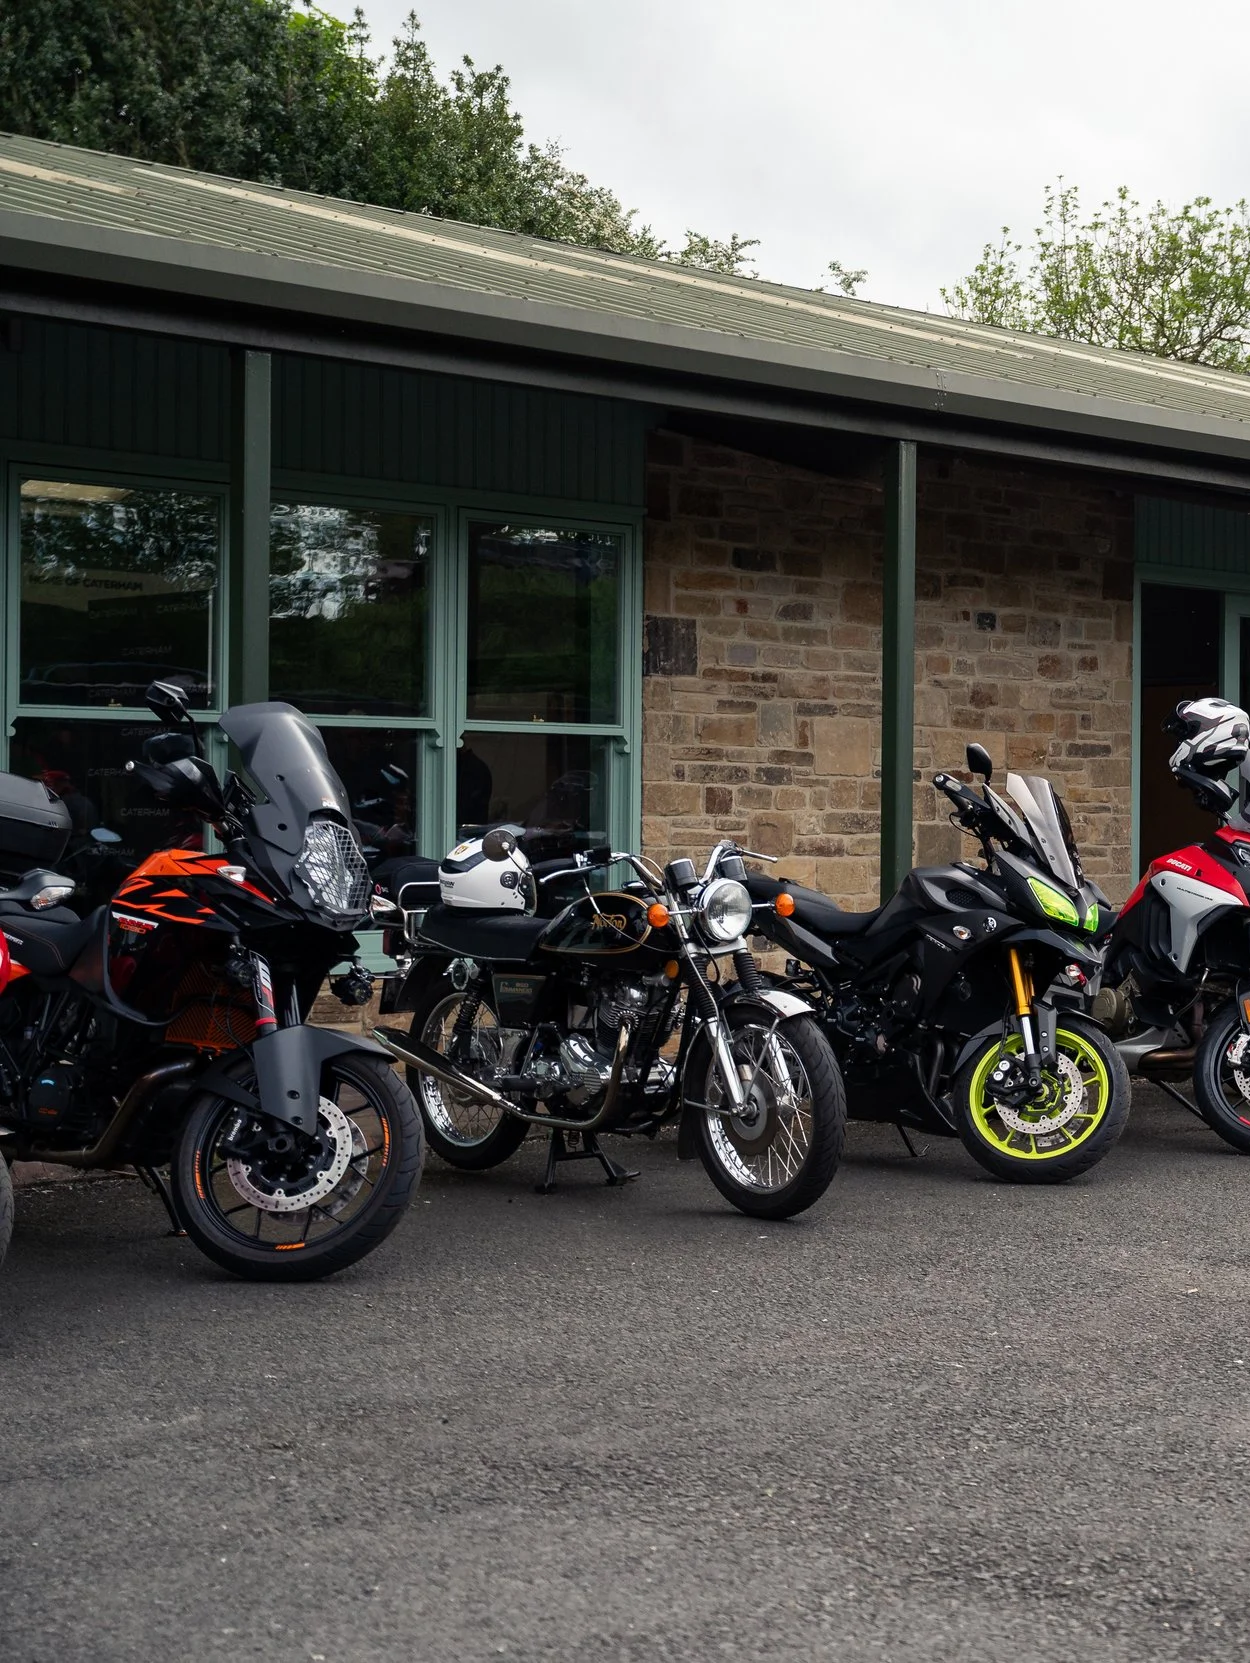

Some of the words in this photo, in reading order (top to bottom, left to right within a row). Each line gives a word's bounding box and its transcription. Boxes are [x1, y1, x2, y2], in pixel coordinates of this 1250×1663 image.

[64, 576, 81, 587] OF
[82, 577, 143, 591] CATERHAM
[121, 645, 172, 656] CATERHAM
[88, 687, 136, 698] CATERHAM
[88, 767, 134, 777] CATERHA
[120, 807, 170, 817] CATERHAM
[1166, 858, 1193, 872] DUCATI
[592, 912, 627, 931] Norton
[227, 1118, 242, 1141] brembo
